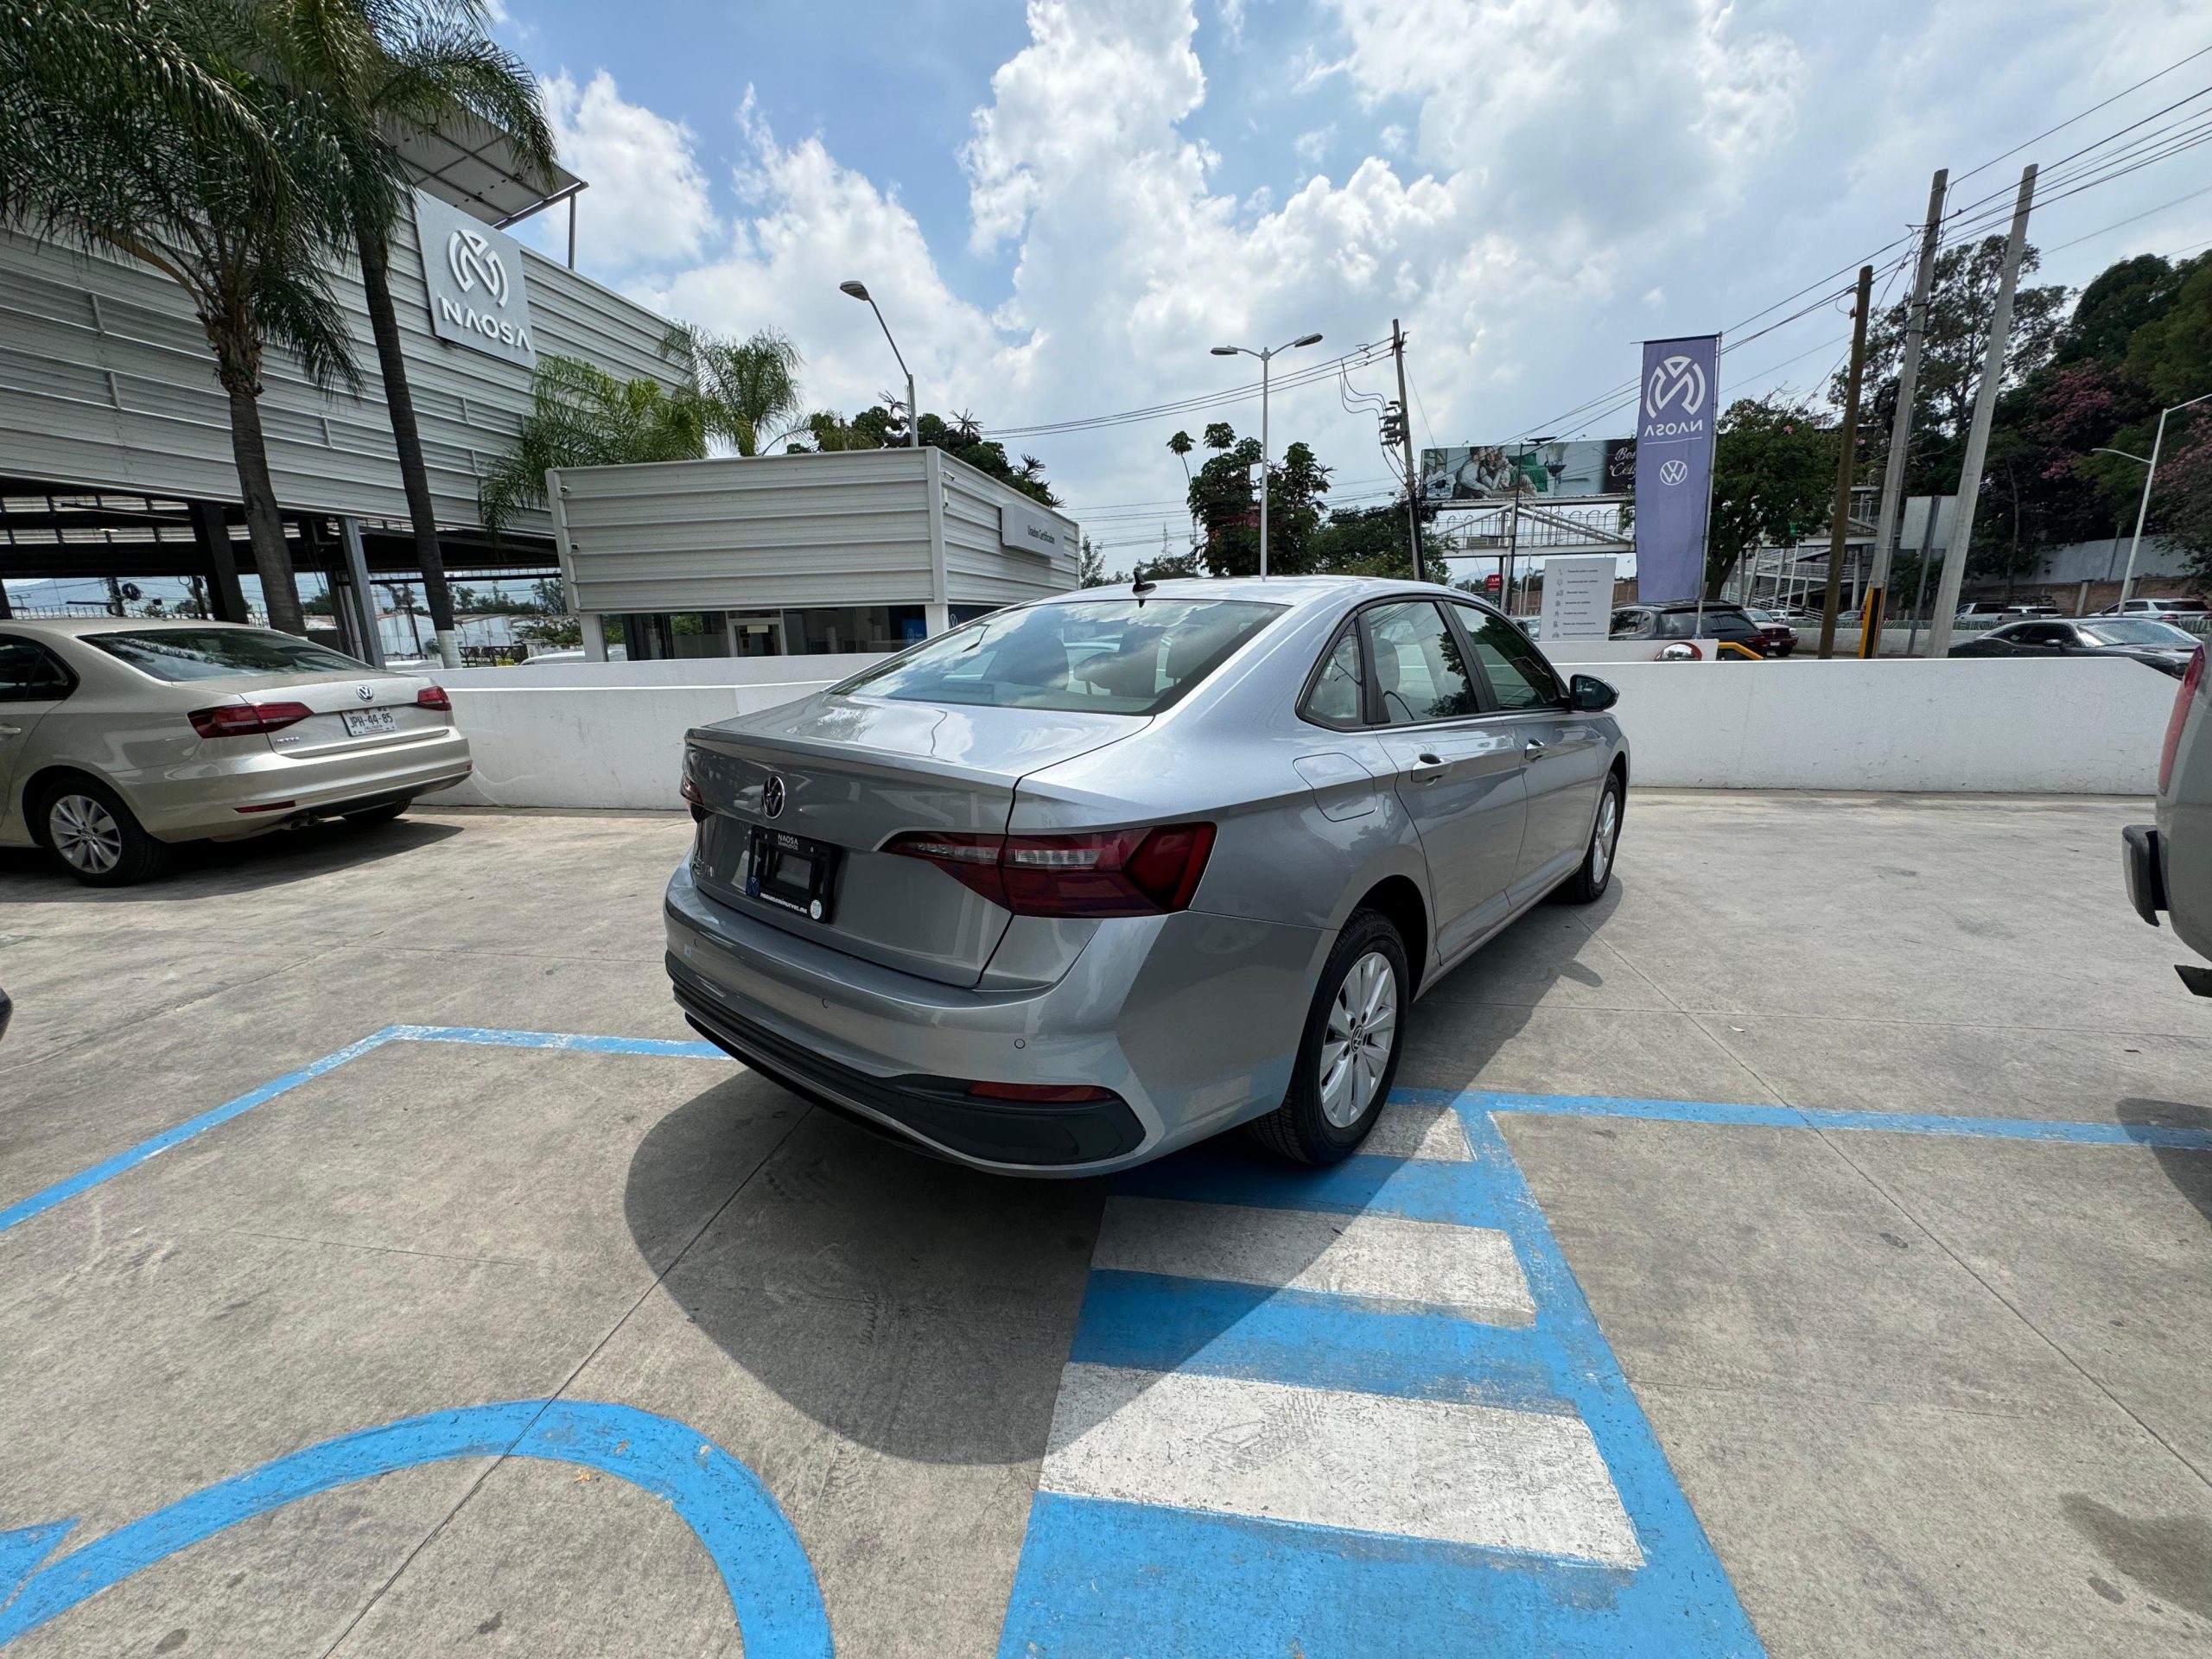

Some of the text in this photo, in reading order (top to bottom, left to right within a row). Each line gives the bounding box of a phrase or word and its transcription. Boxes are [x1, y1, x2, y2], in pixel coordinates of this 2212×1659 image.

[439, 296, 531, 352] NAOSA
[349, 712, 393, 728] JPH-44-85
[778, 832, 798, 846] NAOSA
